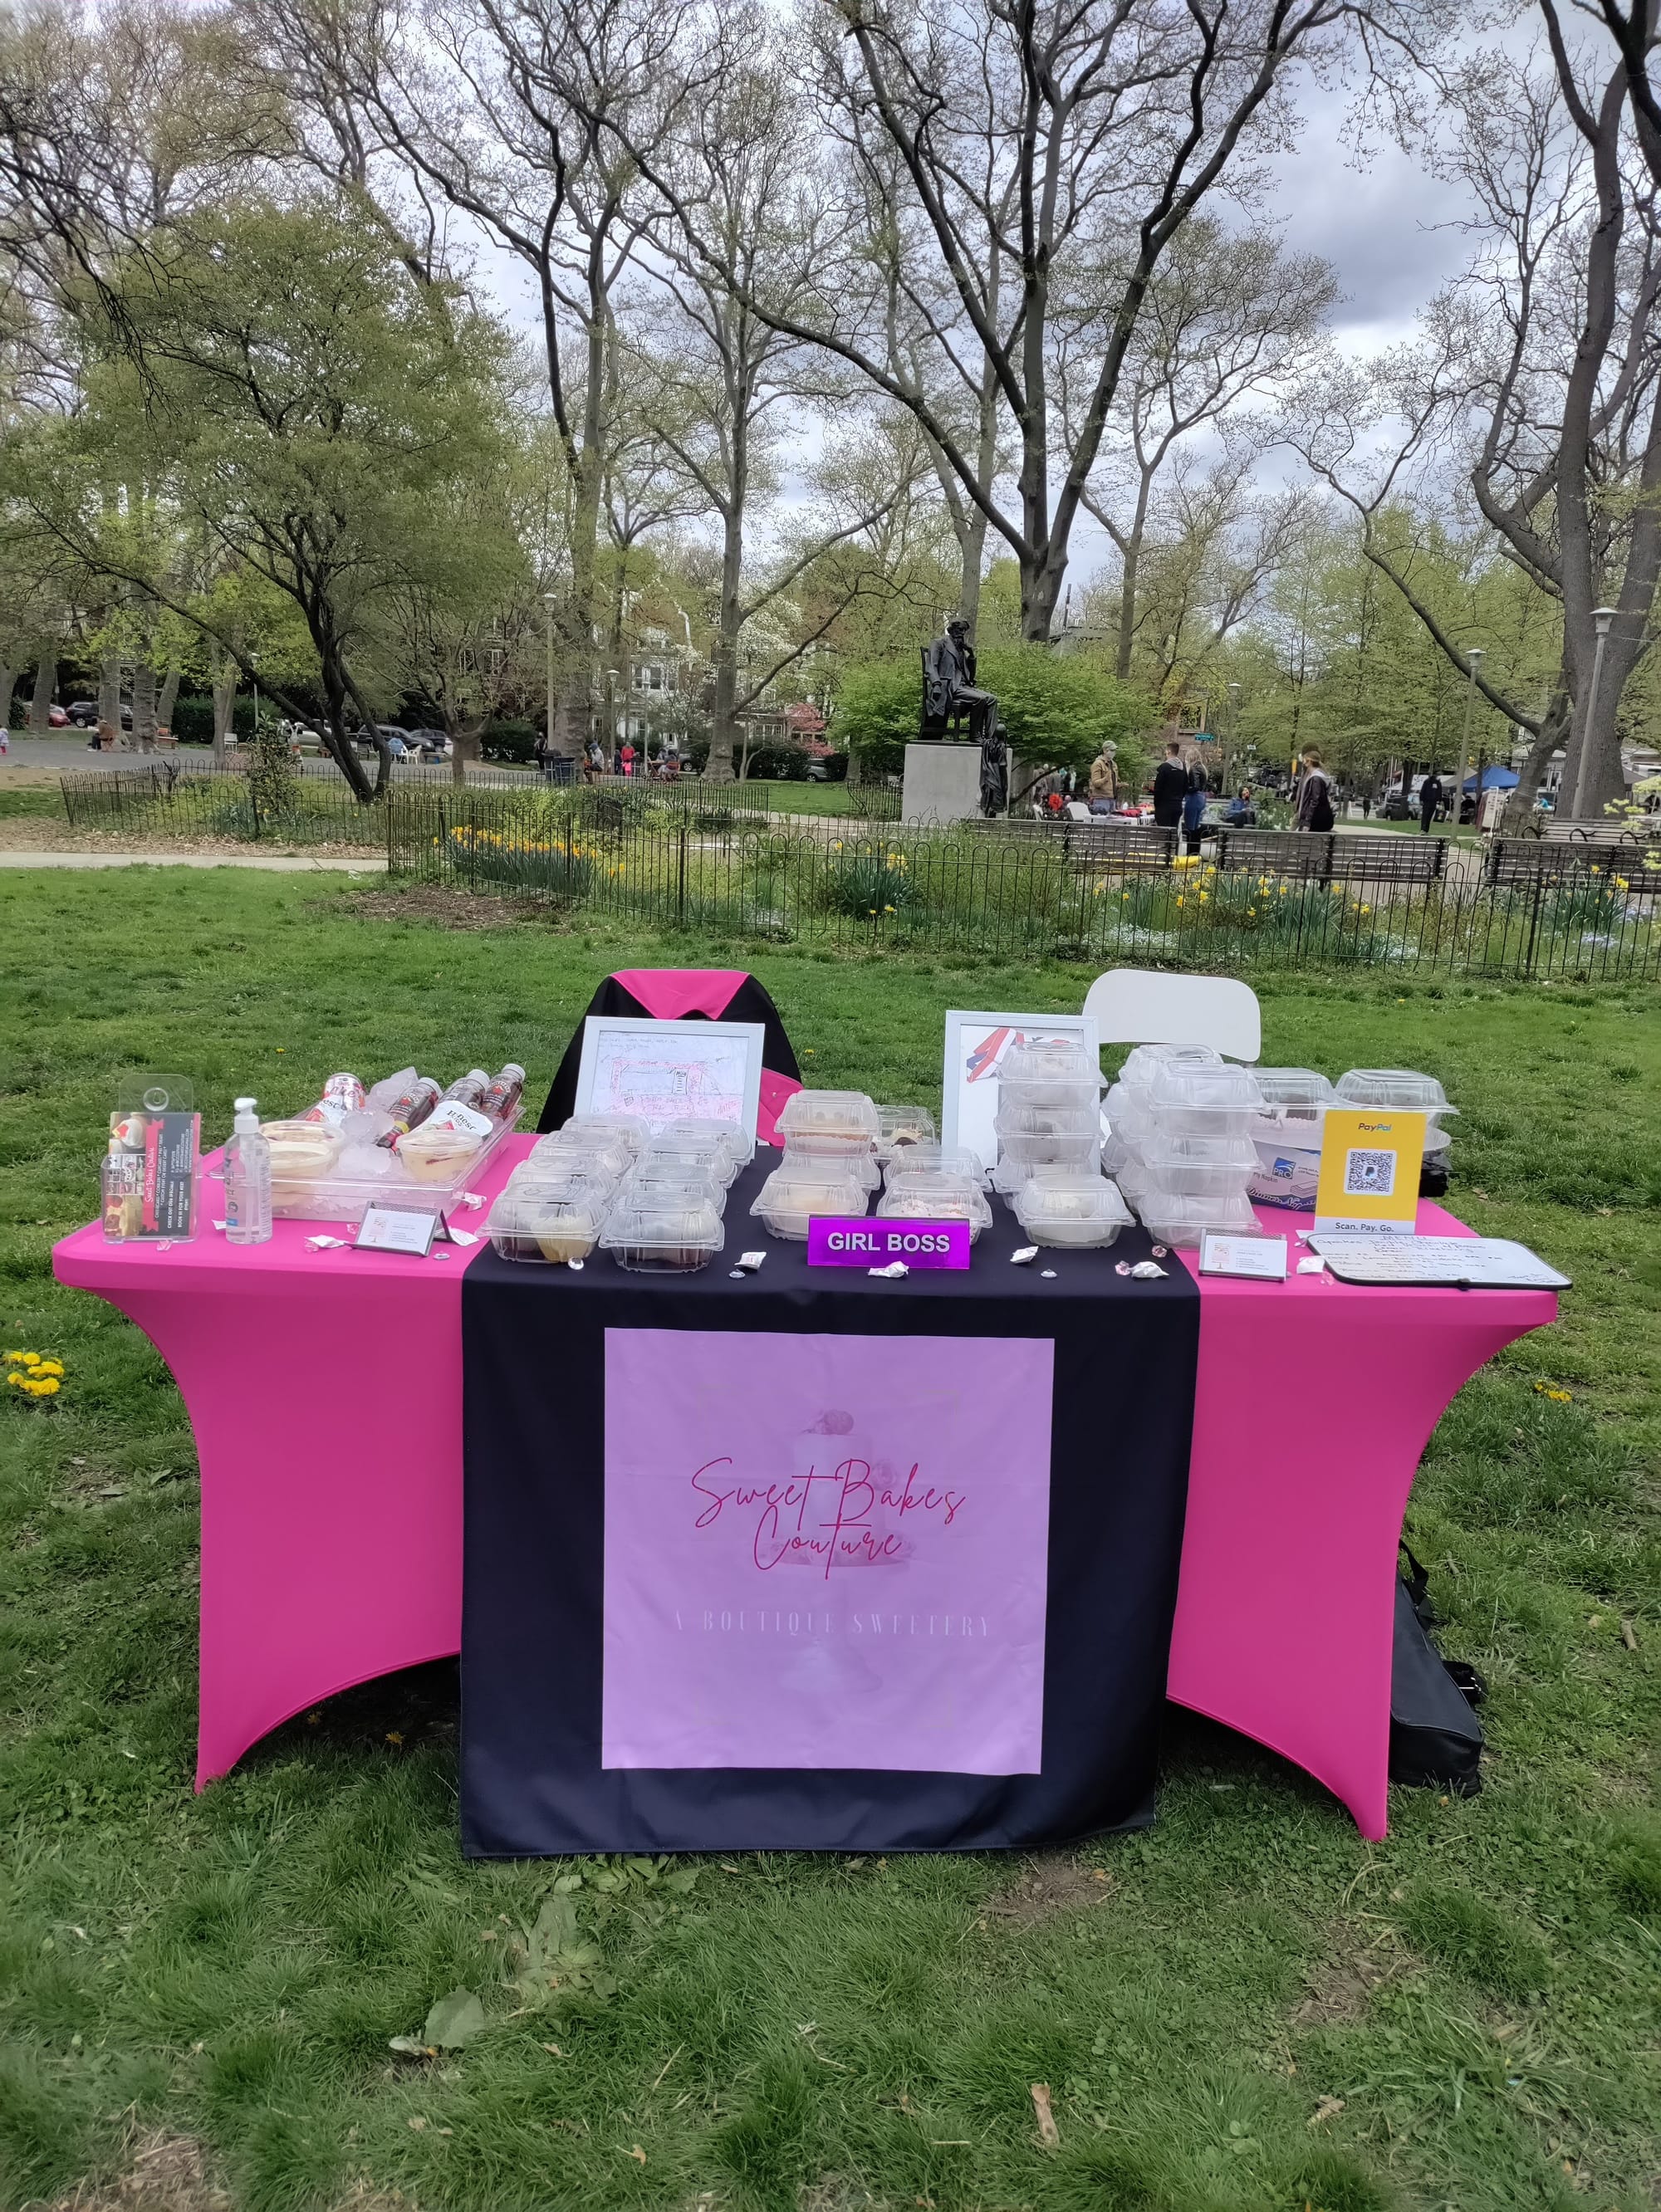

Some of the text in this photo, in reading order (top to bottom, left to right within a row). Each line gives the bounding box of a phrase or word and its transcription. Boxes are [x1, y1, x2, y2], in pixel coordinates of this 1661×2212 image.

[1358, 1123, 1392, 1133] PayPal
[1274, 1167, 1292, 1179] PRO
[1335, 1222, 1358, 1231] Scan.
[1360, 1223, 1378, 1233] Pay.
[827, 1232, 950, 1253] GIRL BOSS
[691, 1456, 966, 1531] Sweet Bakes
[753, 1505, 902, 1580] Couture
[703, 1610, 835, 1637] BOUTIQUE
[852, 1613, 990, 1637] SWEETERY
